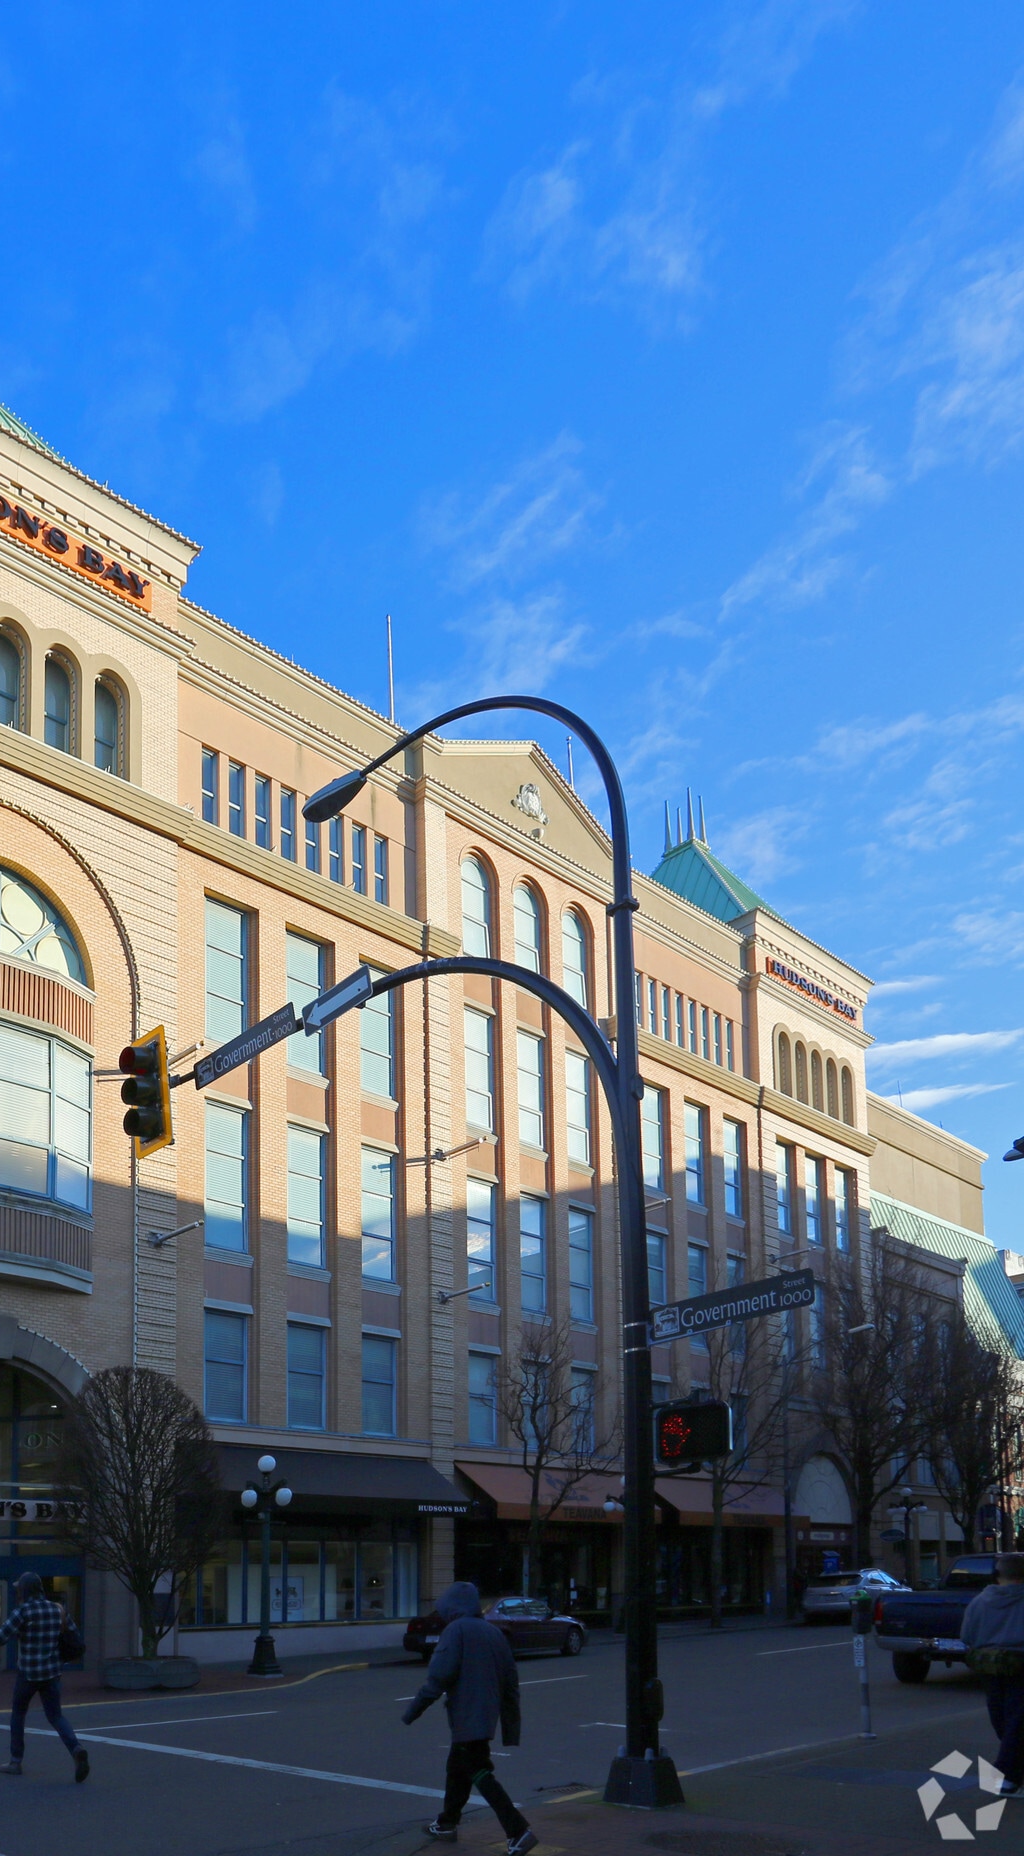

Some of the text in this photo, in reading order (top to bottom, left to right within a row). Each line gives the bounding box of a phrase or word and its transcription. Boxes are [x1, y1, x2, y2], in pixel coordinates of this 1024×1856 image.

[78, 543, 151, 600] BAY
[771, 959, 858, 1020] HUDSON'S BAY
[272, 1008, 290, 1024] Street
[214, 1021, 293, 1073] Government 1000
[783, 1277, 806, 1289] Street
[680, 1288, 812, 1328] Government 1000
[35, 1503, 89, 1519] BY
[418, 1504, 468, 1513] HUDSON'S BAY
